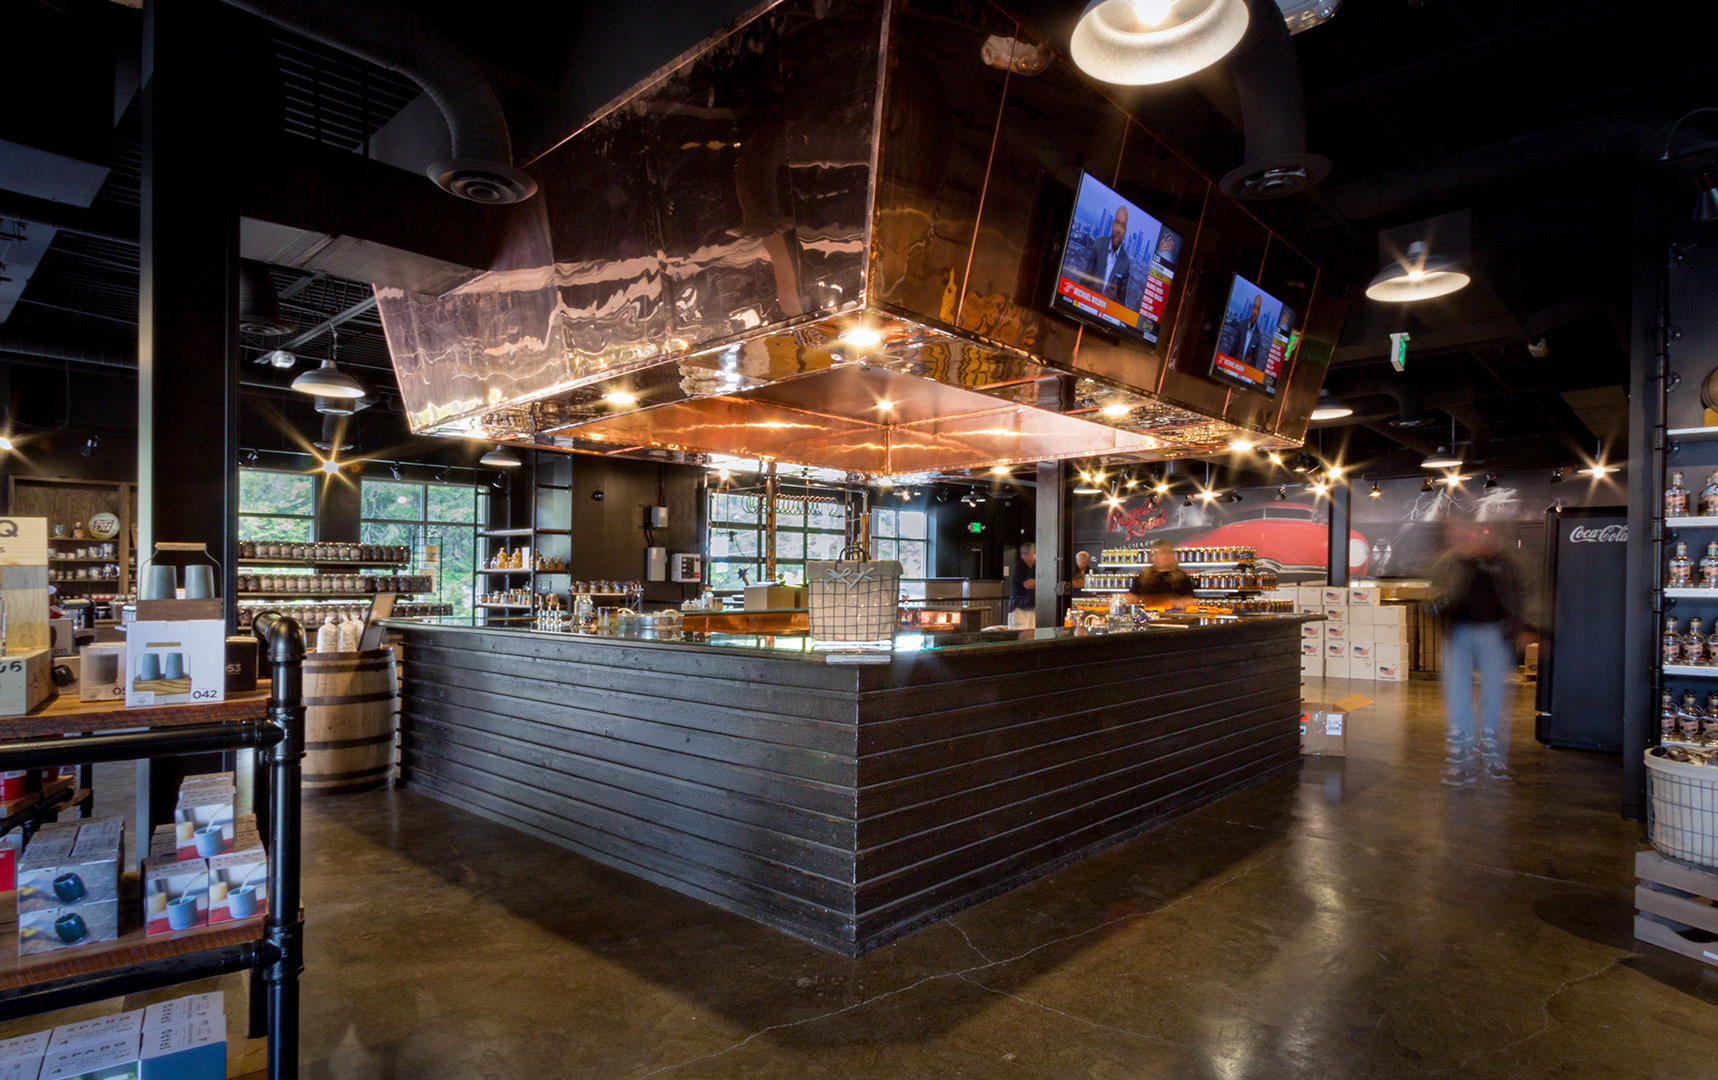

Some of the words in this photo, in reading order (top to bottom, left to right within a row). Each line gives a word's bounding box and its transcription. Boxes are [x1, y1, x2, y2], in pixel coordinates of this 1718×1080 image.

[1126, 508, 1168, 541] Road
[1569, 524, 1629, 543] Coca-Cola
[225, 664, 241, 673] 53
[192, 689, 218, 700] 042
